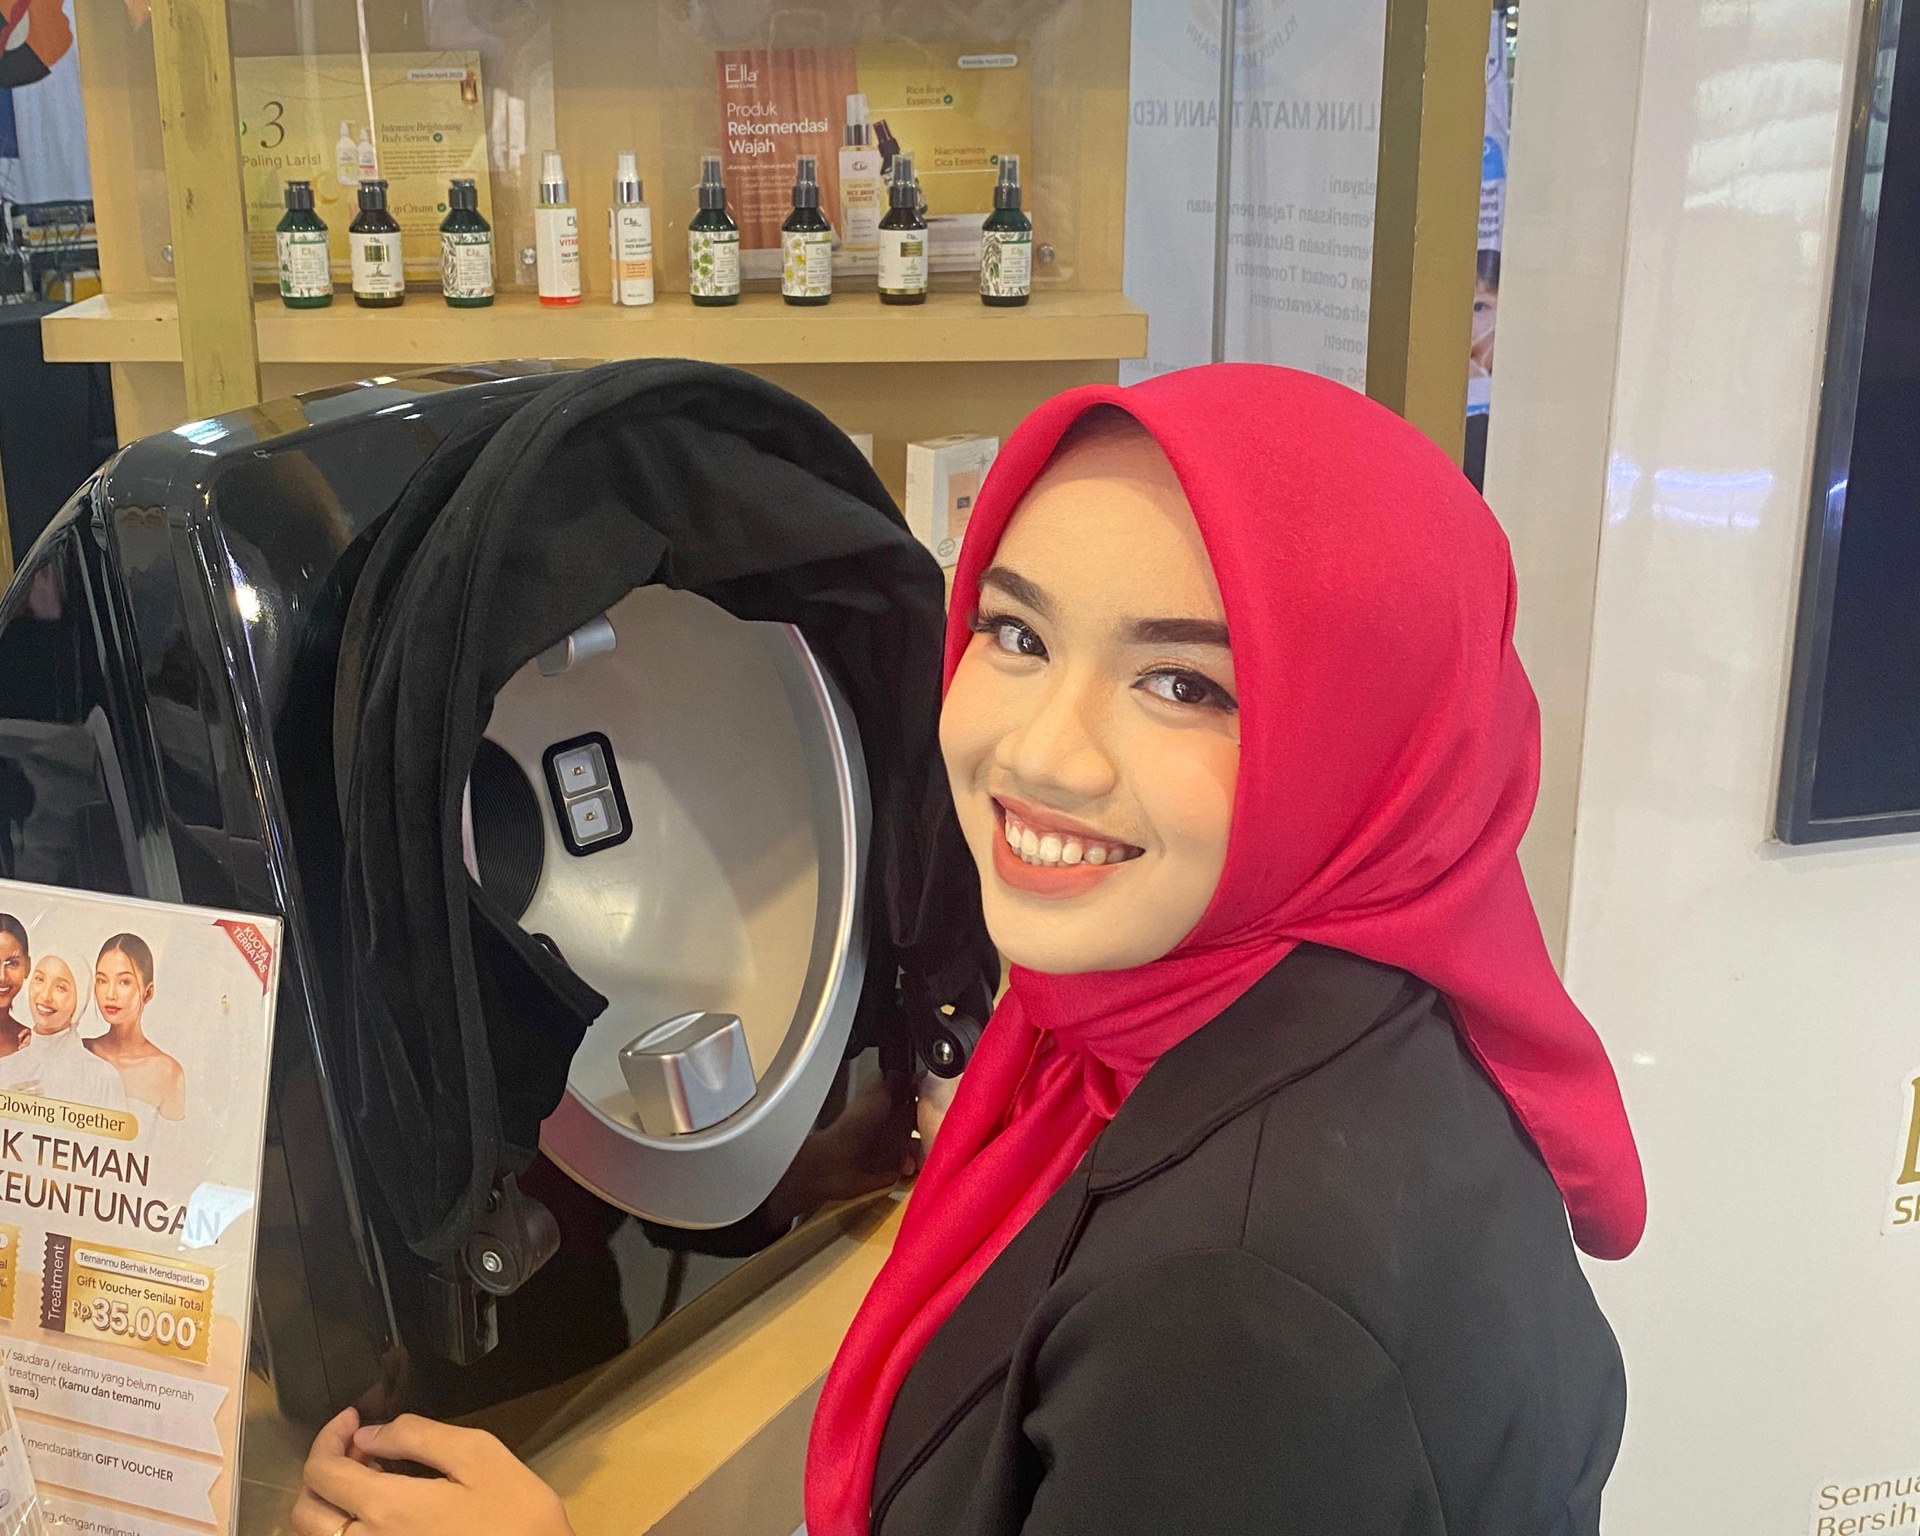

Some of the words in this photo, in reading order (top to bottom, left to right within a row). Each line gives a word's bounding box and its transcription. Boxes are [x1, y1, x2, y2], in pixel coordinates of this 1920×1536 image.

[725, 64, 757, 83] Ella
[907, 86, 924, 95] Rice
[926, 85, 946, 94] Bran
[907, 96, 942, 106] Essence
[727, 101, 778, 117] Produk
[260, 101, 285, 149] 3
[728, 118, 828, 136] Rekomendasi
[729, 138, 776, 157] Wajah
[934, 147, 986, 157] Niacinamide
[242, 155, 282, 169] Paling
[286, 153, 322, 166] Laris!
[955, 156, 988, 166] Essence
[403, 203, 434, 214] Cream
[233, 926, 268, 973] TERBATAS
[244, 926, 269, 961] KUOTA
[0, 1095, 55, 1123] Glowing
[60, 1106, 125, 1132] Together
[32, 1134, 150, 1187] TEMAN
[48, 1244, 65, 1320] Treatment
[80, 1252, 119, 1269] Temanmu
[120, 1261, 148, 1275] Berhak
[149, 1266, 205, 1287] Mendapatkan
[76, 1275, 97, 1289] Gift
[99, 1280, 142, 1298] Voucher
[143, 1289, 177, 1306] Senilai
[179, 1296, 204, 1312] Total
[9, 1366, 57, 1386] treatment
[59, 1376, 89, 1394] (kamu
[91, 1385, 110, 1399] dan
[112, 1390, 161, 1410] temanmu
[12, 1351, 49, 1368] saudara
[57, 1362, 99, 1379] rekanmu
[100, 1372, 124, 1387] yang
[126, 1375, 157, 1393] belum
[158, 1385, 194, 1401] pernah
[9, 1384, 39, 1400] sama)
[28, 1438, 94, 1462] mendapatkan
[95, 1453, 119, 1468] GIFT
[121, 1459, 174, 1482] VOUCHER
[59, 1514, 96, 1532] dengan
[1817, 1502, 1916, 1536] Bersih
